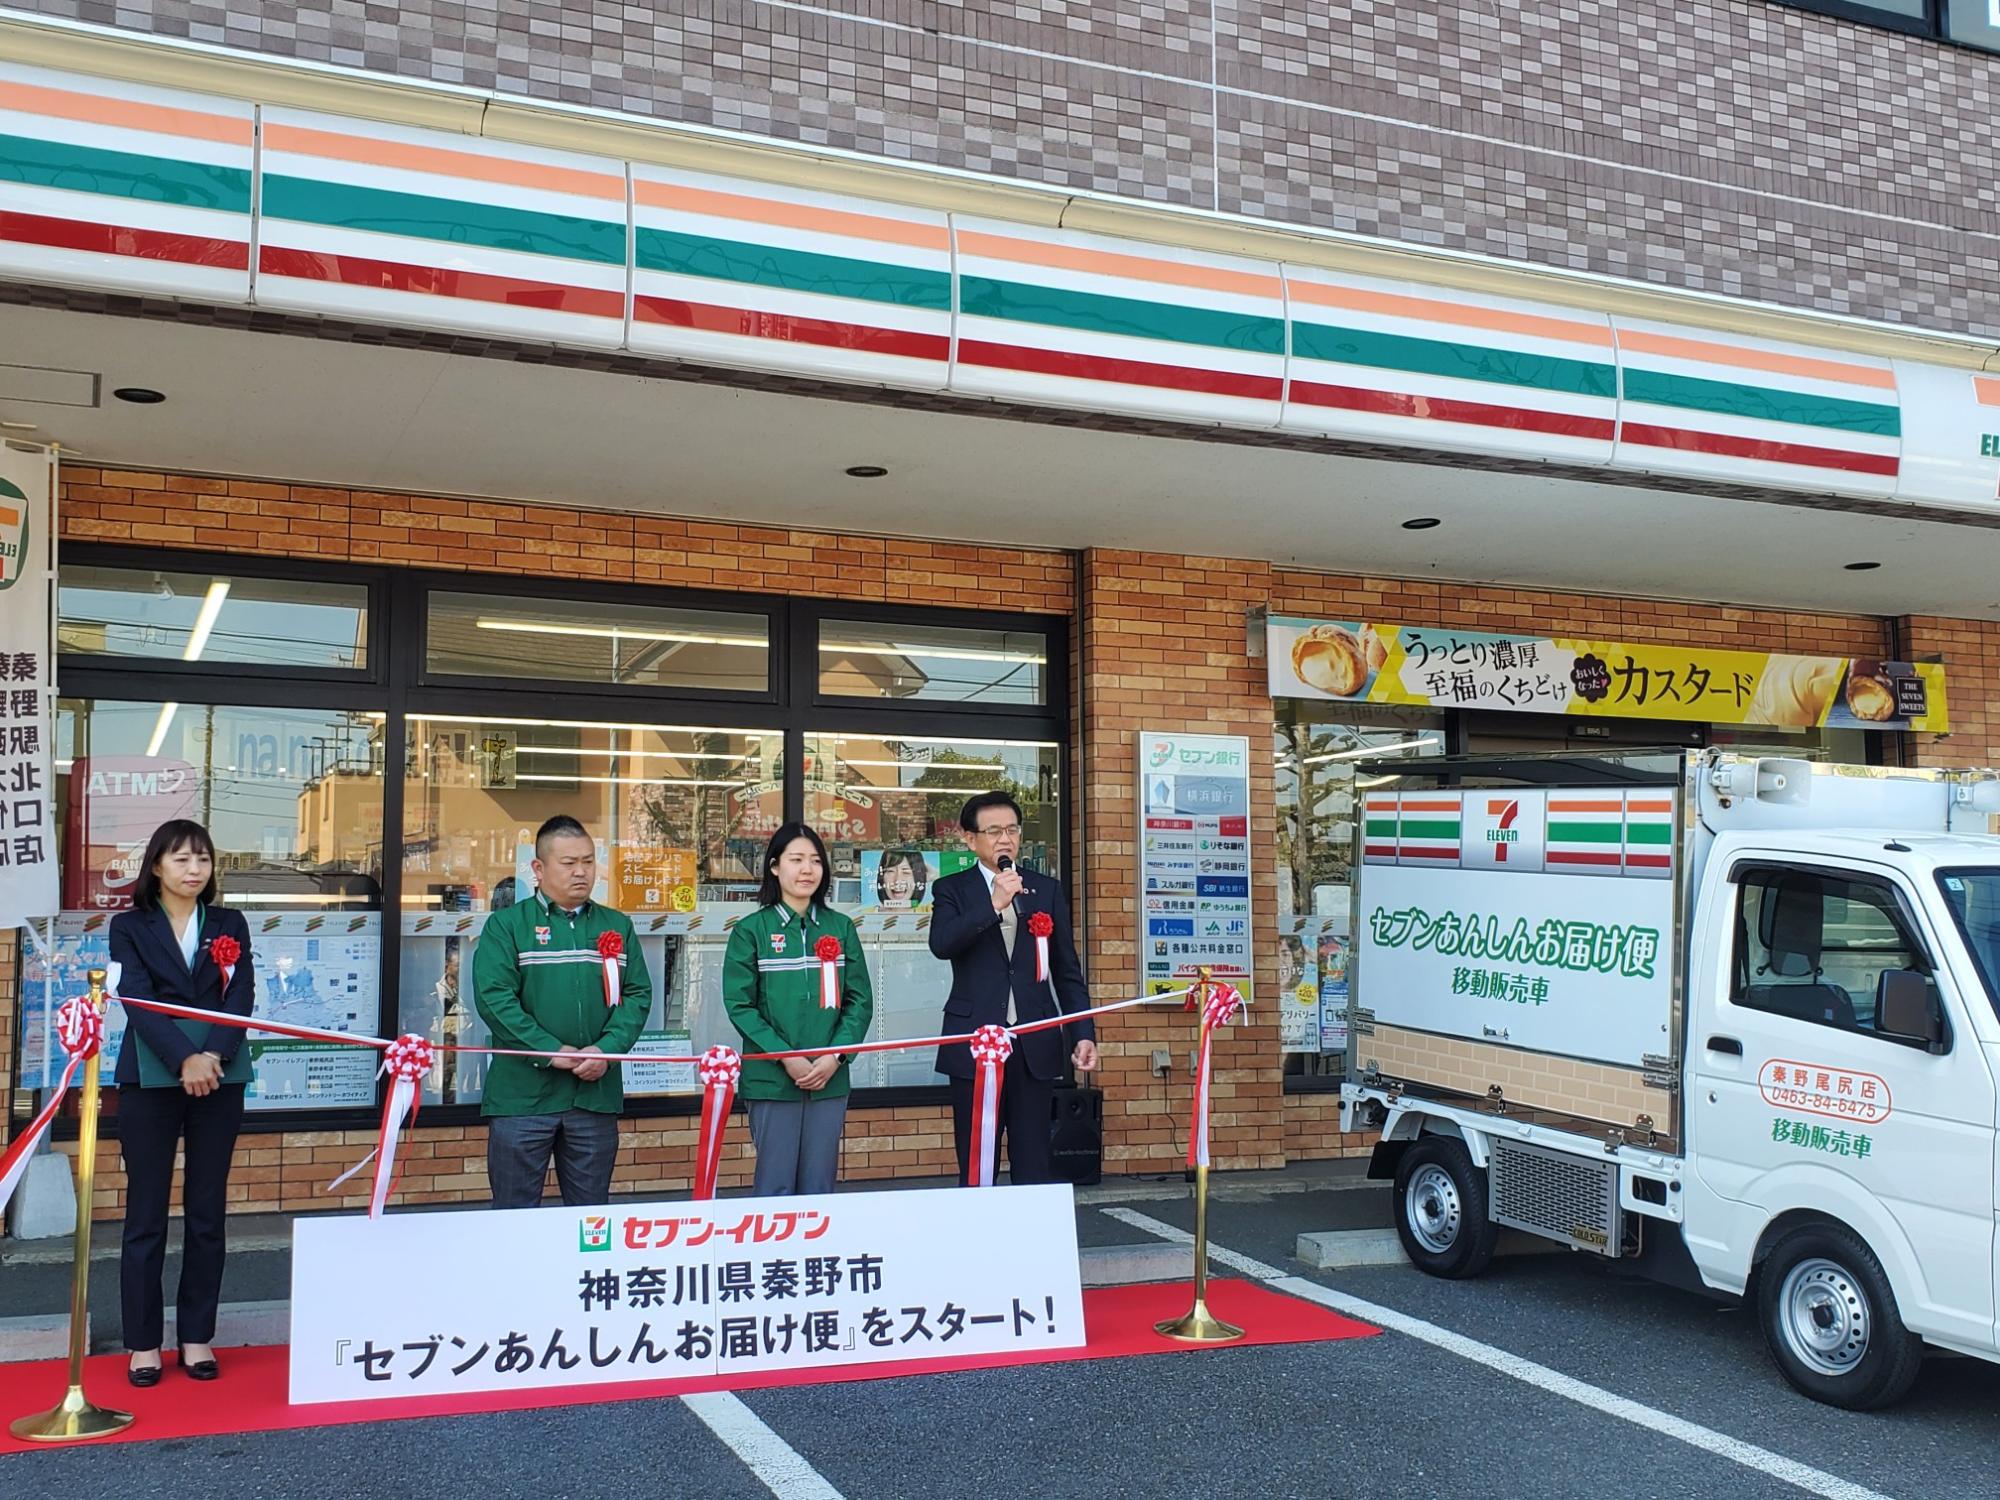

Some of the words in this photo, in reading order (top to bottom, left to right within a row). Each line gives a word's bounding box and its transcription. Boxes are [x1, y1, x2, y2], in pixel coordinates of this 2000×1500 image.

[1405, 633, 1541, 670] うっとり濃厚
[1575, 665, 1606, 679] おいしく
[1613, 655, 1754, 708] カスタード
[1425, 669, 1568, 705] 至福のくちどけ
[1577, 679, 1601, 691] なった
[1900, 702, 1925, 711] SWEETS
[1901, 692, 1923, 700] SEVEN
[1178, 748, 1240, 766] セブン銀行
[87, 771, 157, 796] ATM
[1187, 789, 1234, 804] 横浜銀行
[1210, 841, 1244, 851] りそな銀行
[1487, 829, 1518, 842] ELEVEN
[112, 859, 144, 871] BAN
[1161, 880, 1194, 889] スルガ銀行
[1163, 901, 1195, 910] 信用金庫
[1172, 943, 1243, 954] 各種公共料金窓口
[1370, 906, 1660, 978] セブンあんしんお届け便
[1451, 966, 1550, 1006] 移動販売車
[1772, 1065, 1876, 1099] 秦野尾尻店
[1772, 1087, 1877, 1118] 0463-84-6475
[1771, 1117, 1873, 1159] 移動販売車
[623, 1211, 830, 1249] セブン-イレブン
[578, 1253, 884, 1312] 神奈川県秦野市
[335, 1296, 1056, 1381] 『セブンあんしんお届け便』をスタート!
